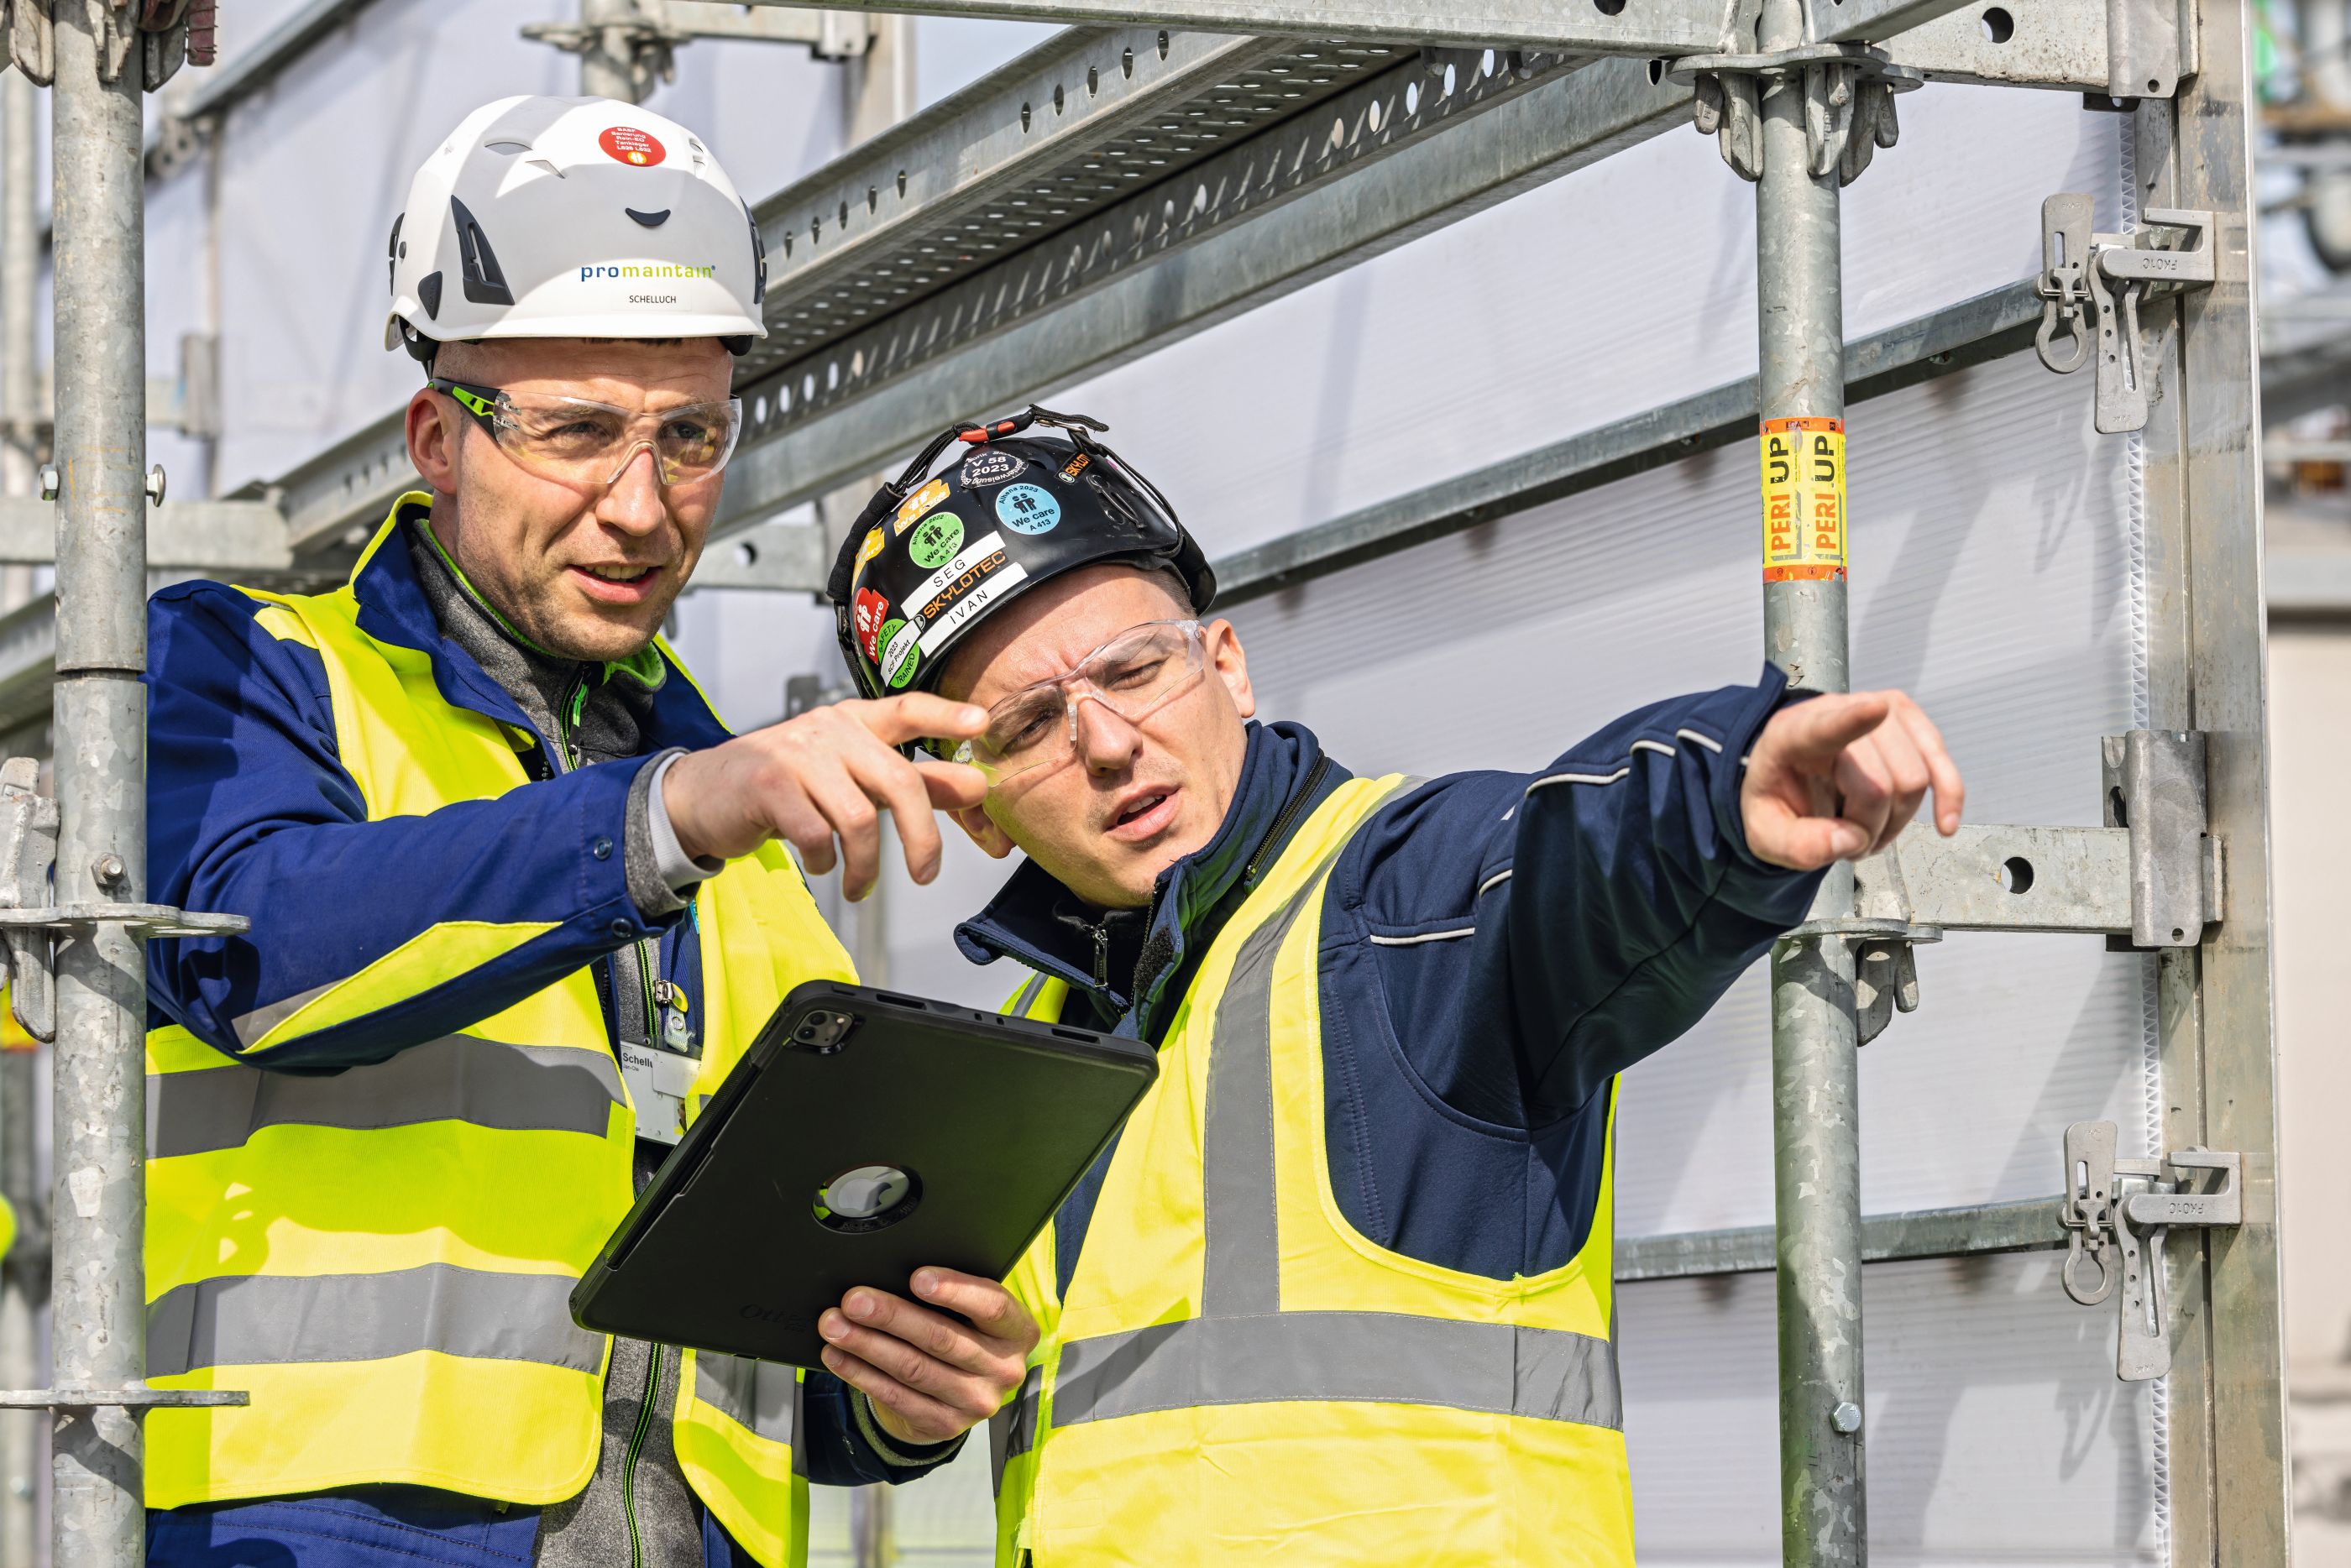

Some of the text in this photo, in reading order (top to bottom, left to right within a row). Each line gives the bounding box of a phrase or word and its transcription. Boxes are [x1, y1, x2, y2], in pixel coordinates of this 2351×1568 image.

[629, 295, 677, 303] SCHELLUCH
[972, 463, 1009, 477] 2023
[1769, 436, 1791, 551] PERI UP
[1814, 435, 1836, 550] PERI UP
[1012, 508, 1055, 527] We care
[1037, 519, 1051, 528] 413
[924, 529, 960, 562] We care
[924, 551, 1006, 619] SKYLOTEC
[933, 559, 966, 588] SEG
[950, 589, 988, 625] IVAN
[869, 601, 884, 656] We care
[879, 624, 897, 653] SAFETY
[888, 641, 898, 658] 2023
[893, 640, 911, 661] Projekt
[895, 653, 915, 684] TRAINED
